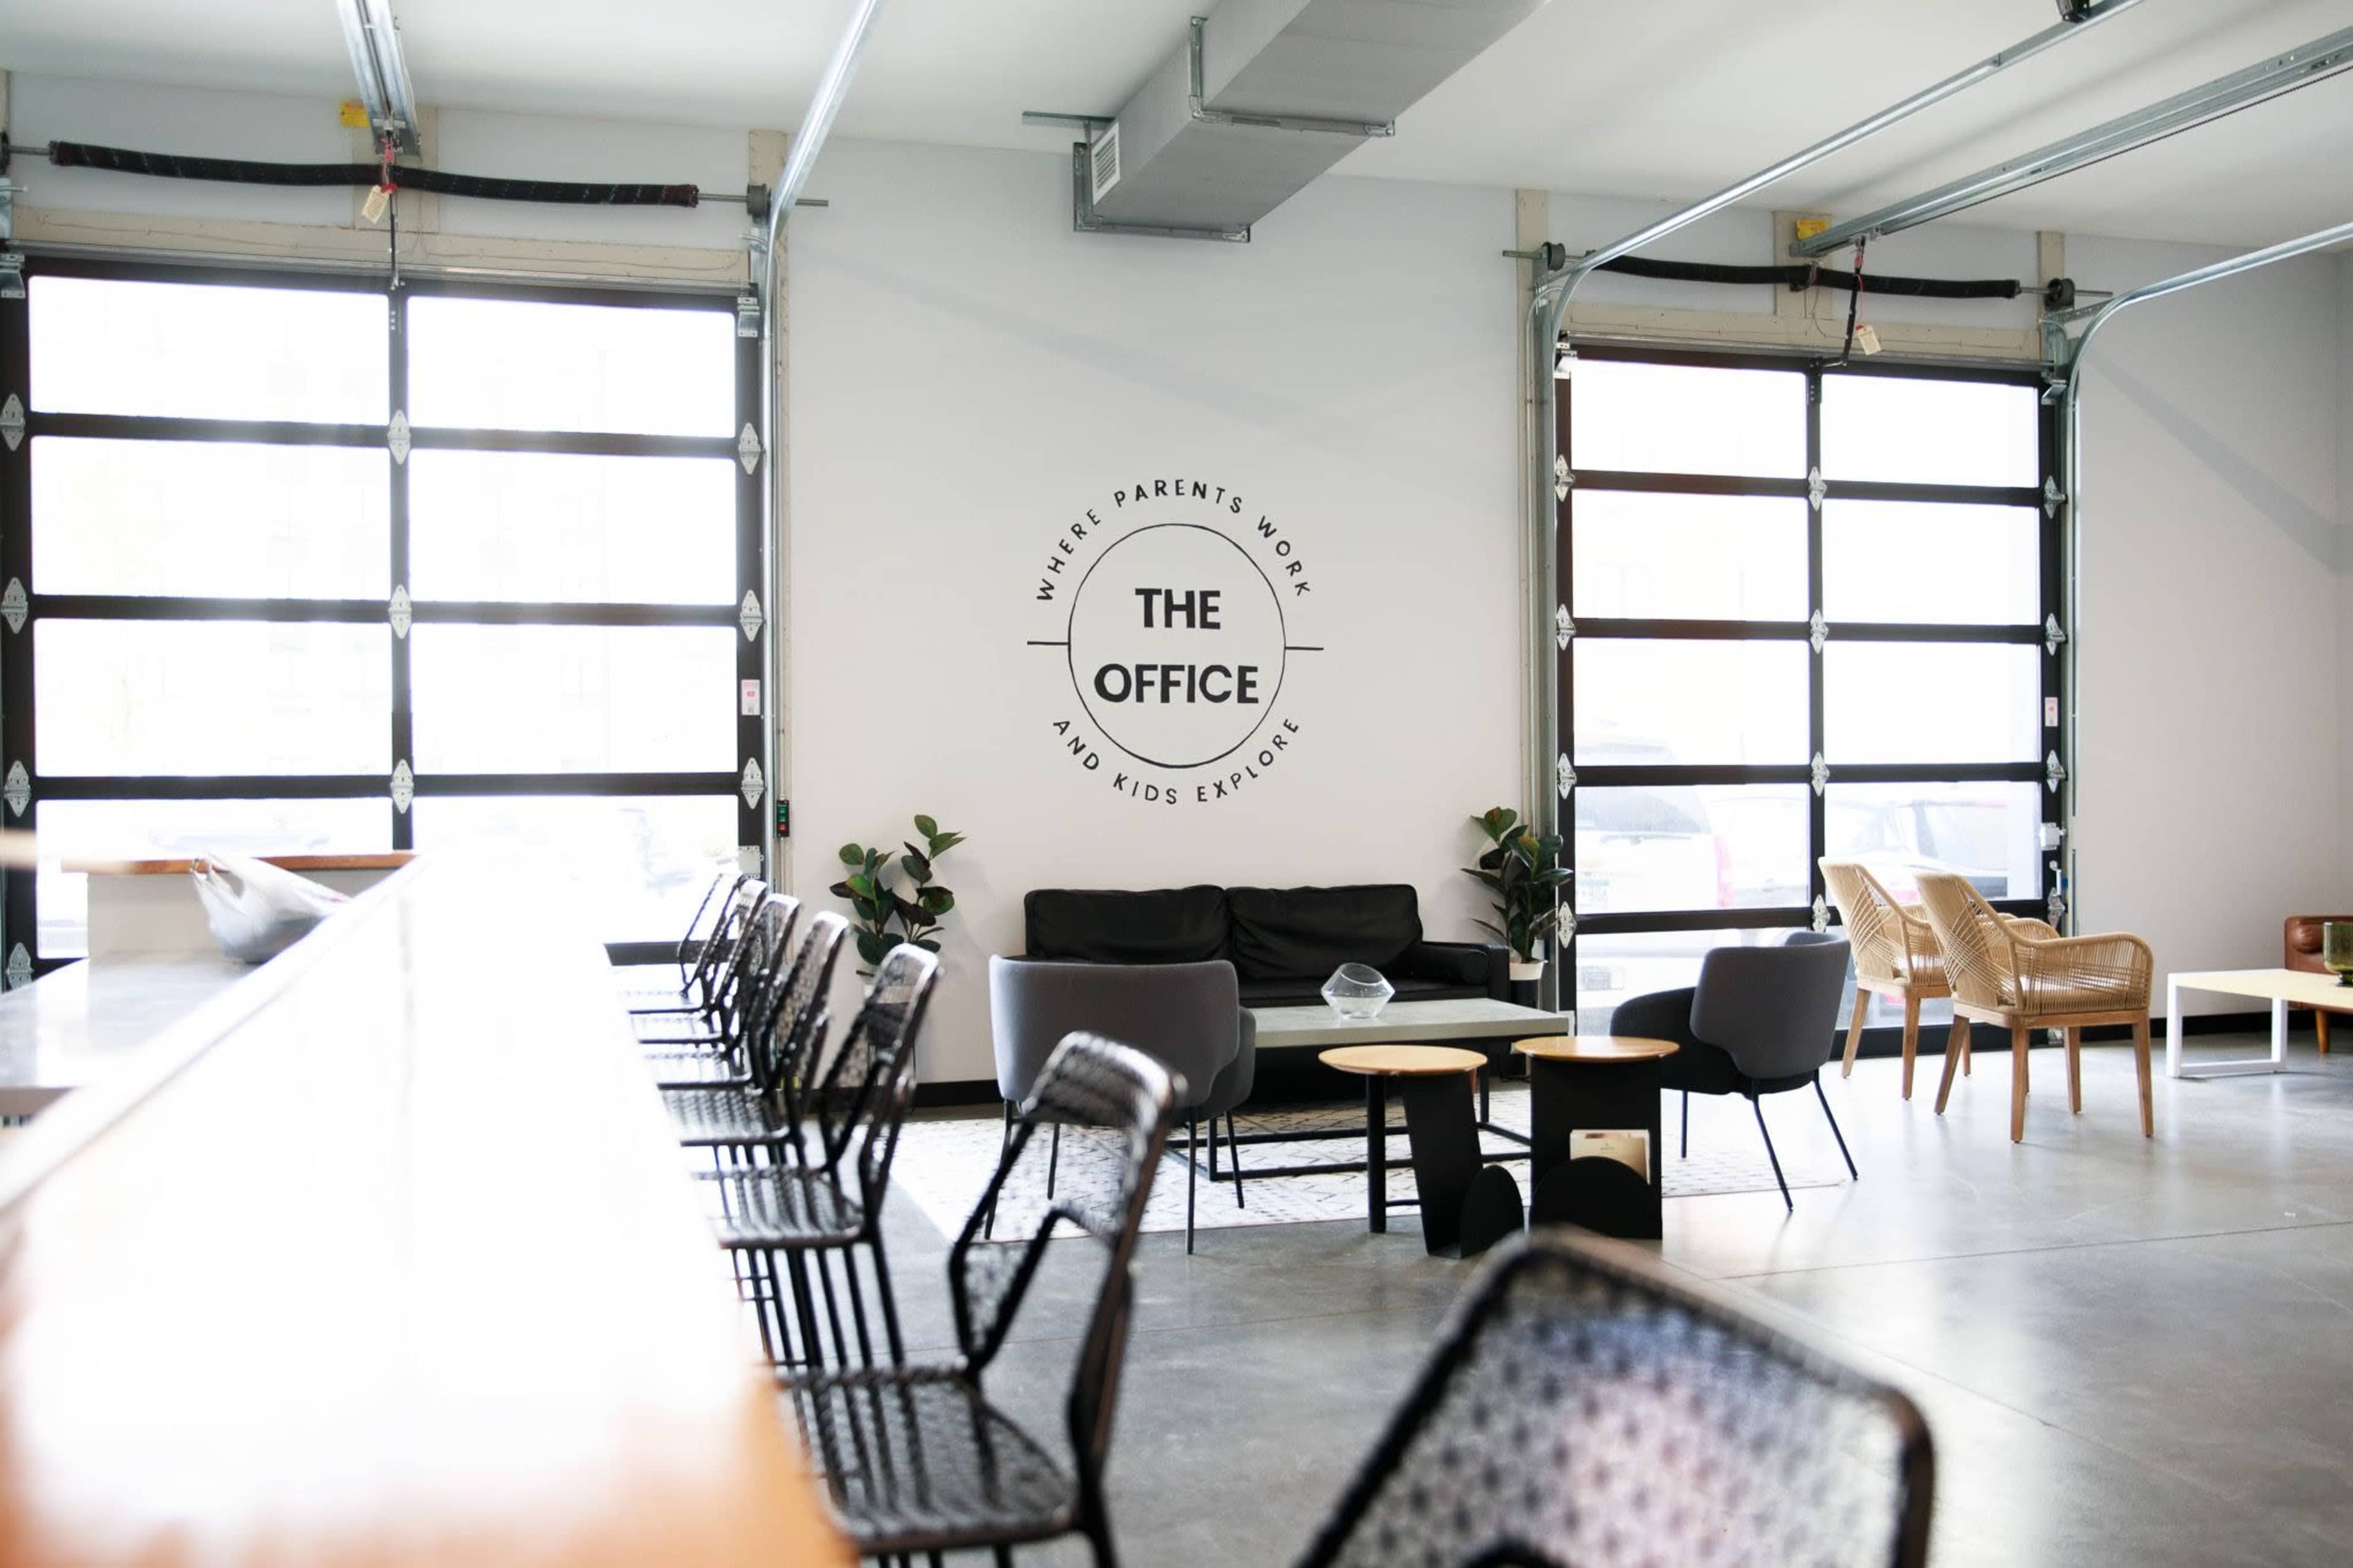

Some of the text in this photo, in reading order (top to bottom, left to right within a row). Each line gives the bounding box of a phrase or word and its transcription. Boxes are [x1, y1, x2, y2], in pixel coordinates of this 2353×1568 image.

[1037, 479, 1311, 600] WHERE PARENTS WORK
[1135, 588, 1221, 630] THE
[1094, 663, 1259, 704] OFFICE
[1053, 718, 1300, 805] AND KIDS EXPLORE
